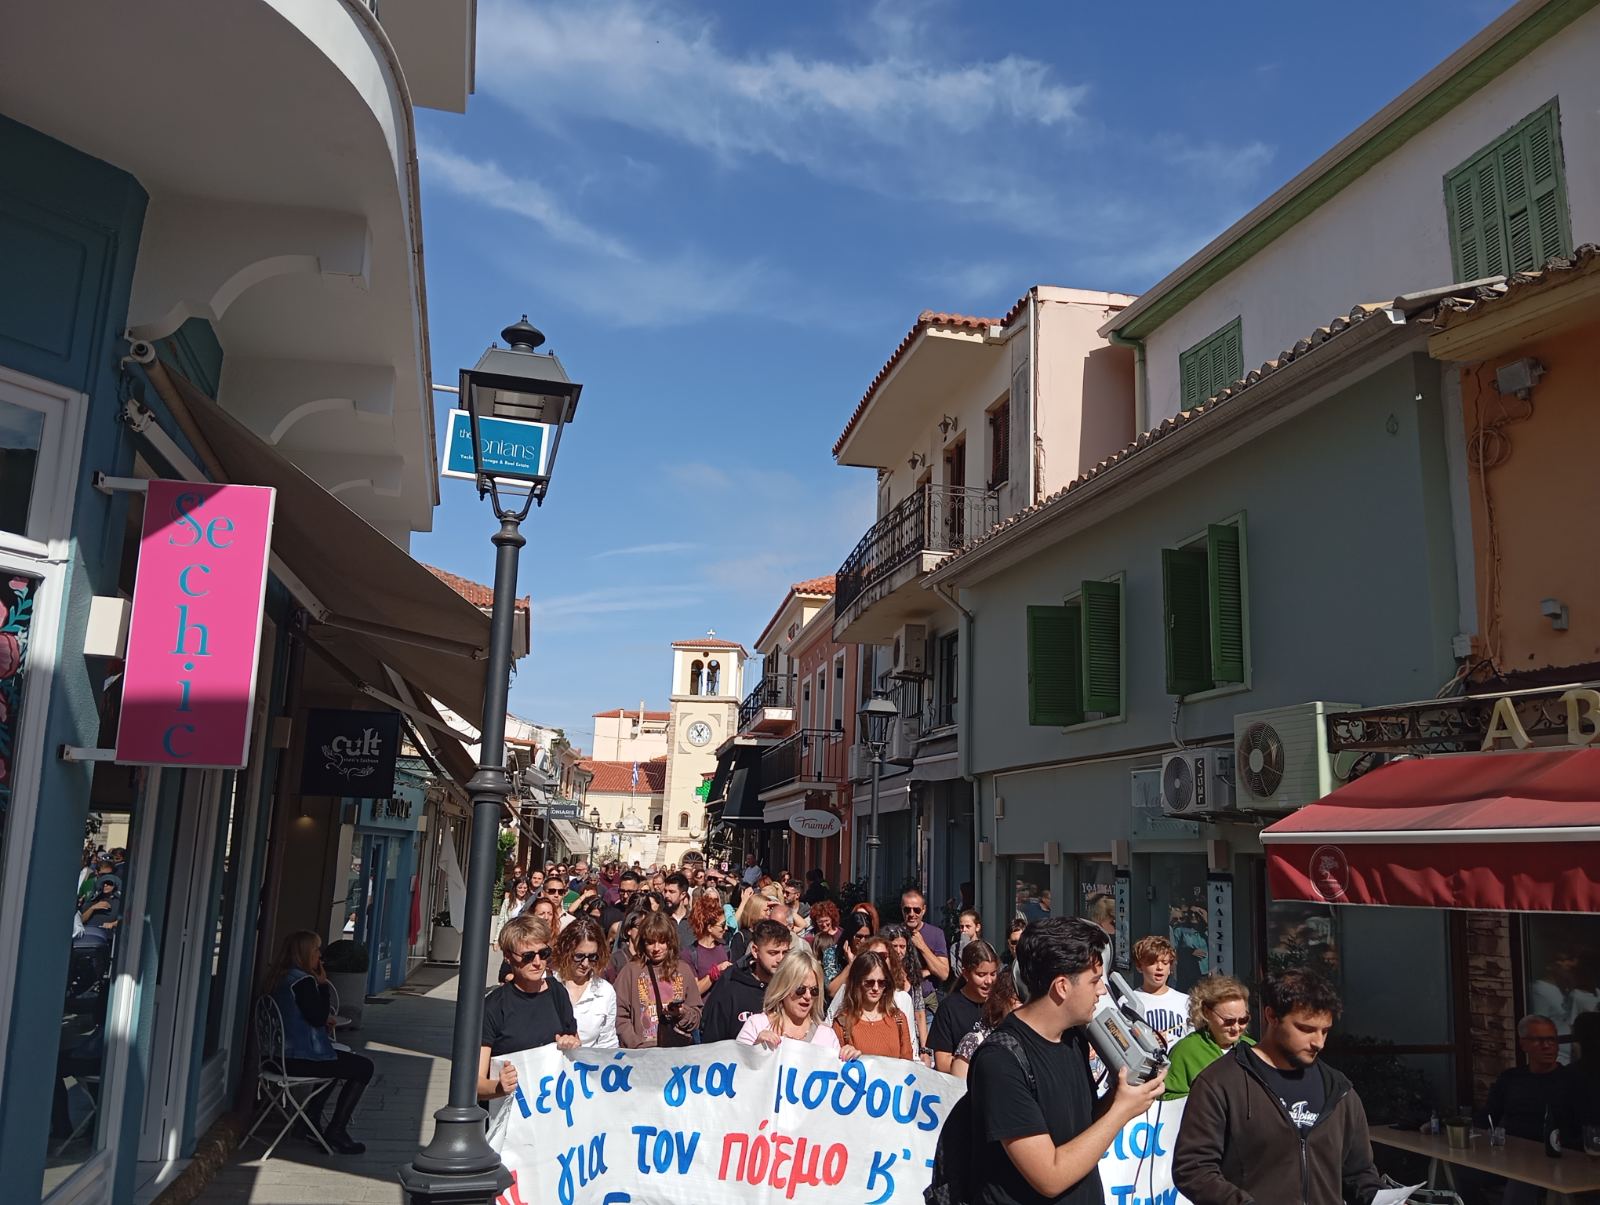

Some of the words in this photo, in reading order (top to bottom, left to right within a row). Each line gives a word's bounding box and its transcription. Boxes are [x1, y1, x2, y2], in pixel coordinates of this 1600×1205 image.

[481, 438, 535, 460] onians
[1197, 760, 1205, 804] TESLA
[1146, 1008, 1183, 1038] DIDAS
[664, 1064, 737, 1107] για
[556, 1132, 608, 1205] για
